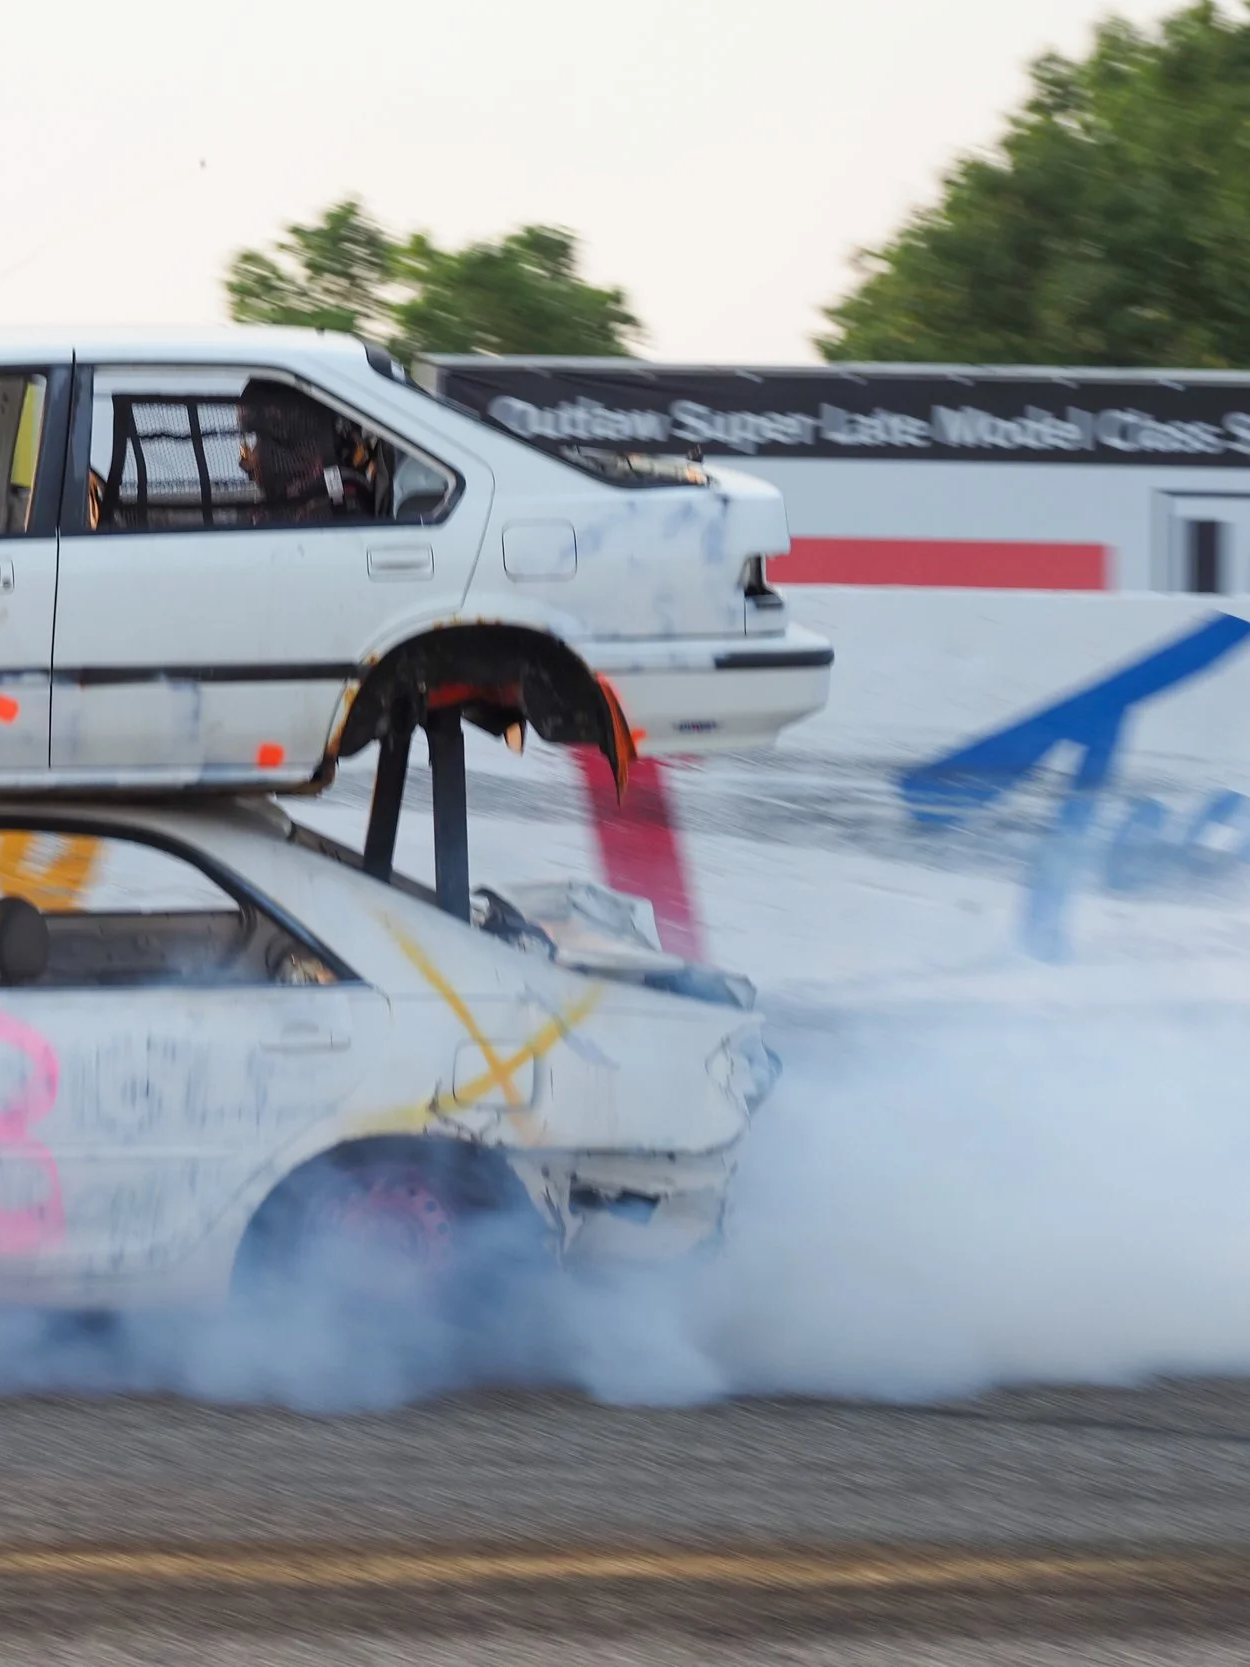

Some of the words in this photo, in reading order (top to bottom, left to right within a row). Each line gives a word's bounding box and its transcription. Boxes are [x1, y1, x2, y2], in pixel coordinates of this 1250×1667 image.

[487, 395, 671, 442] Outlaw
[668, 400, 823, 454] Super
[819, 403, 933, 448] Late
[931, 404, 1096, 451] Model
[1095, 408, 1226, 454] Class
